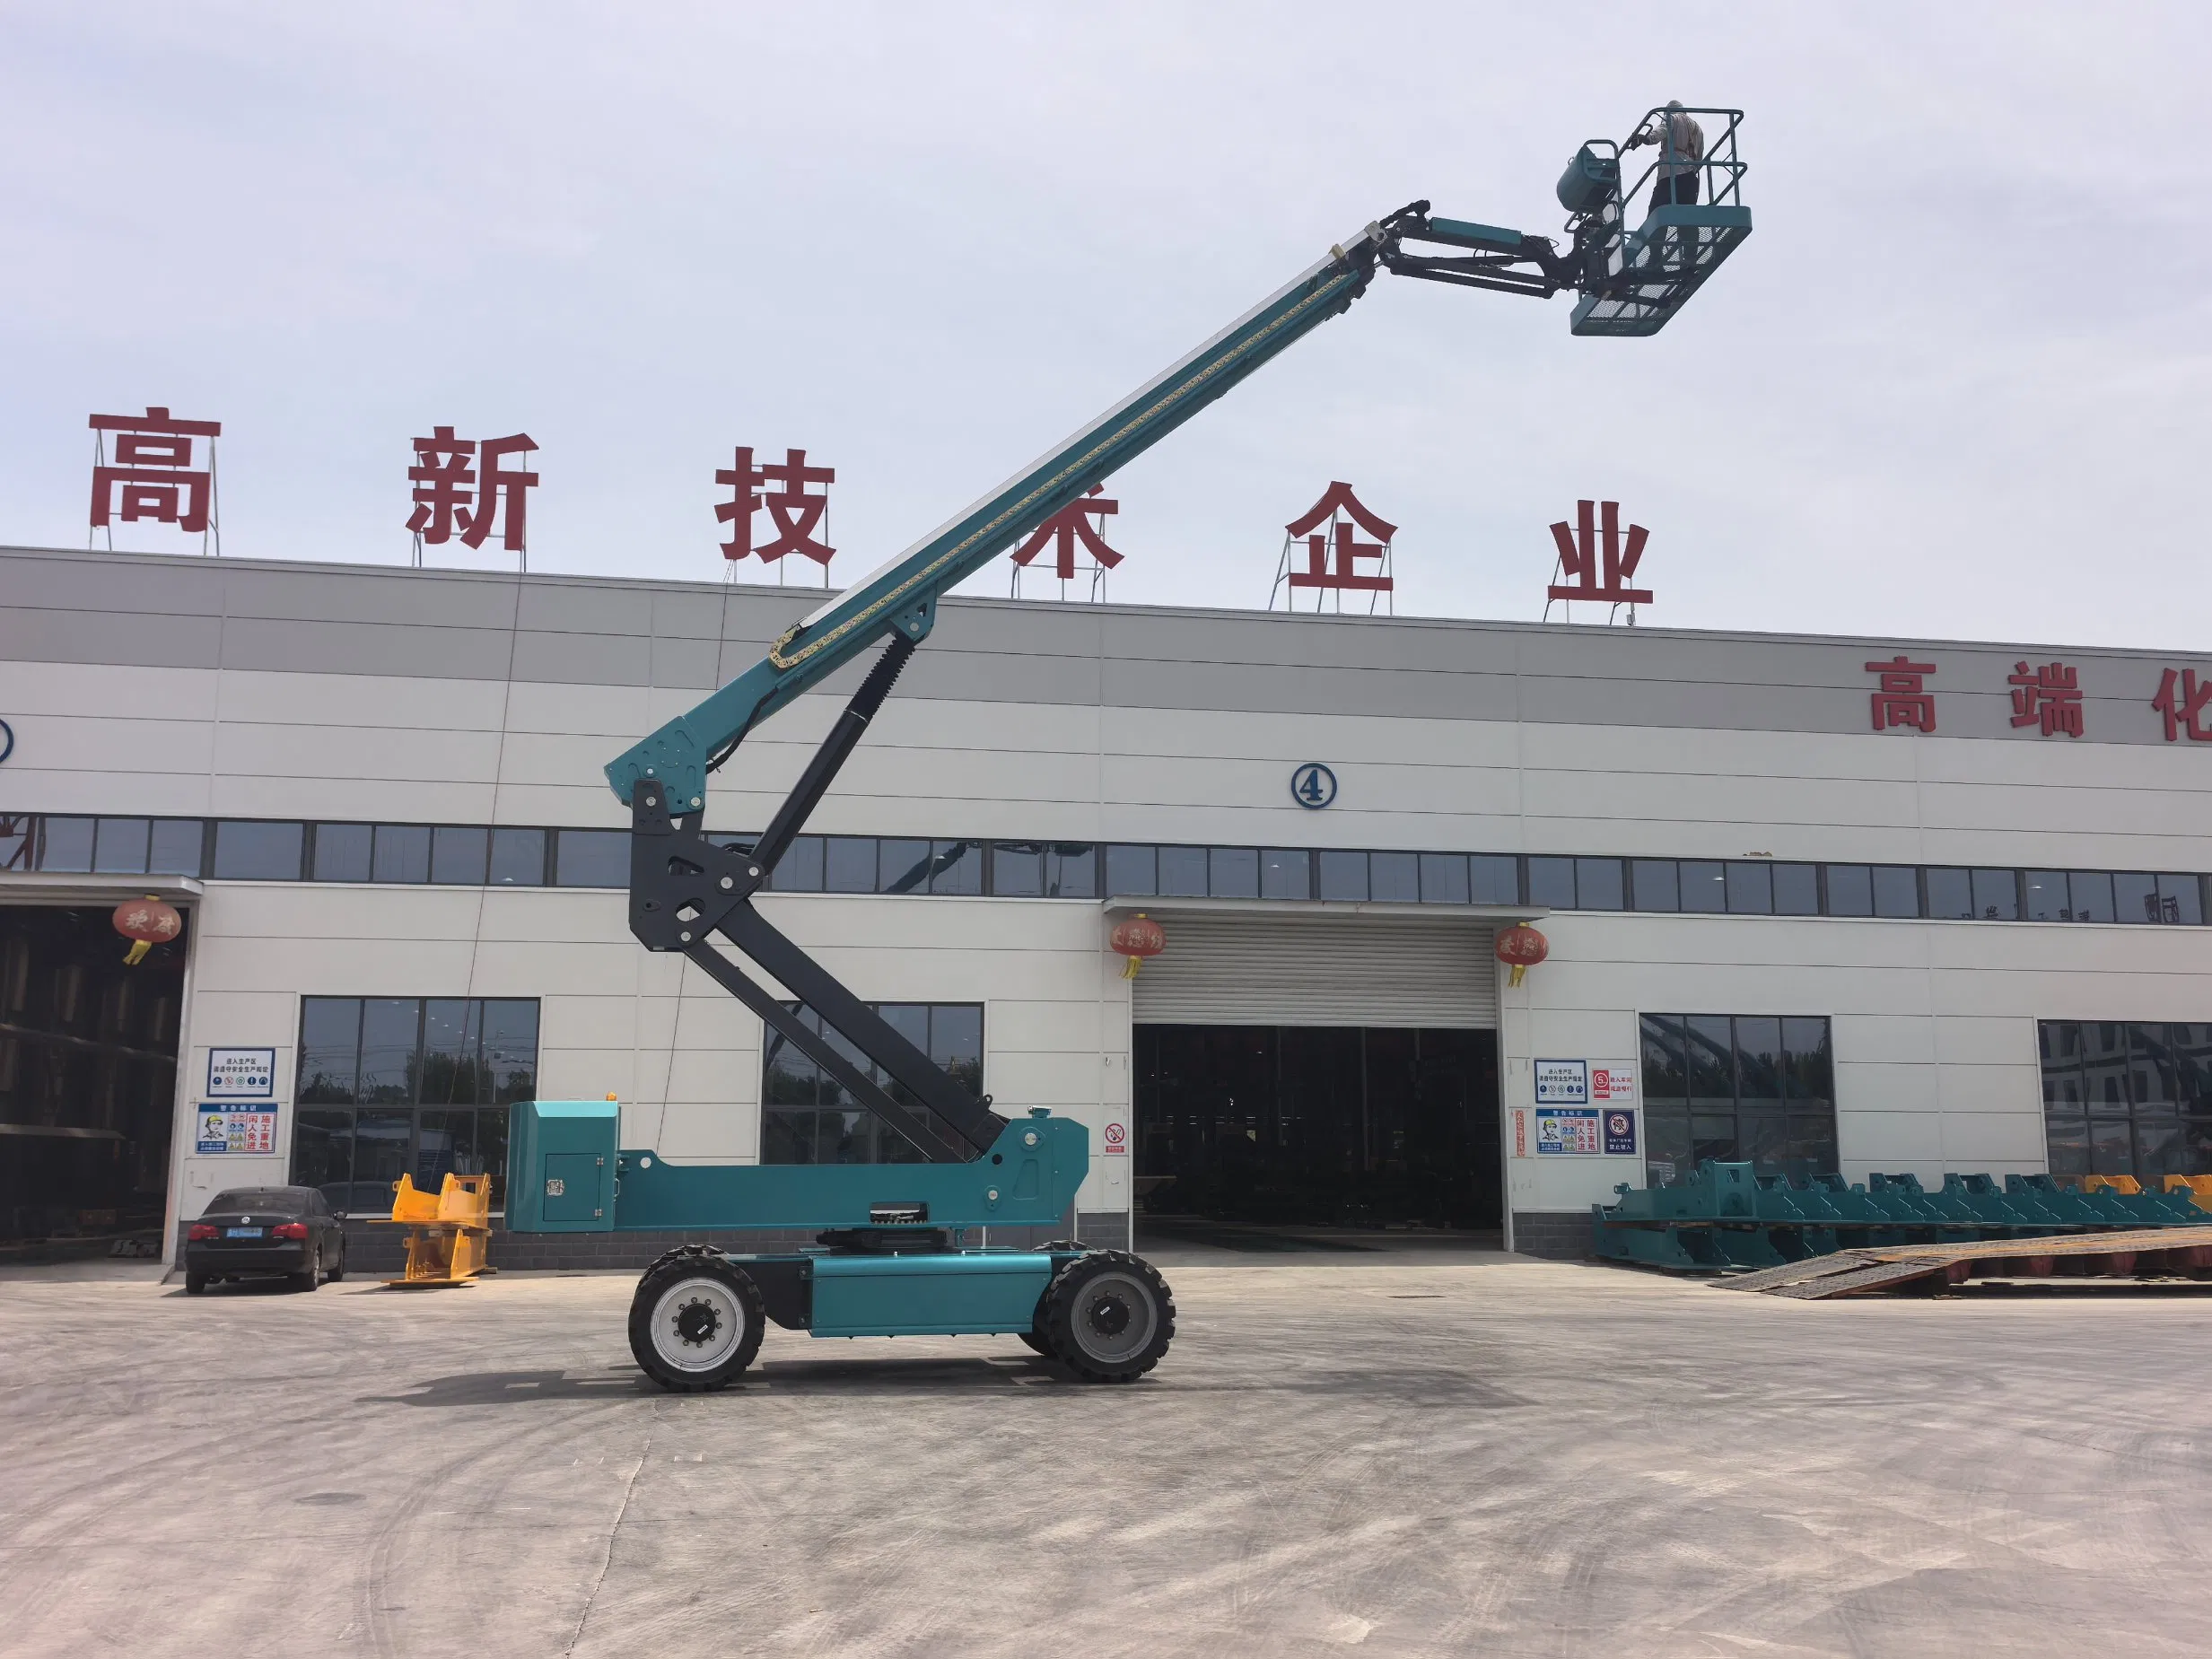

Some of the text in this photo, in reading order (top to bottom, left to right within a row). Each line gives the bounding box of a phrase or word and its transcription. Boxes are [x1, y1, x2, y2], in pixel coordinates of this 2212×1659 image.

[89, 407, 1653, 604] 高新技术企业
[1866, 656, 2212, 742] 高端化
[1299, 769, 1324, 800] 4
[1597, 1076, 1604, 1085] 5
[247, 1115, 258, 1150] 闲人免进
[258, 1115, 271, 1150] 施工重地
[1577, 1119, 1586, 1150] 闲人免进
[1587, 1119, 1596, 1151] 施工重地
